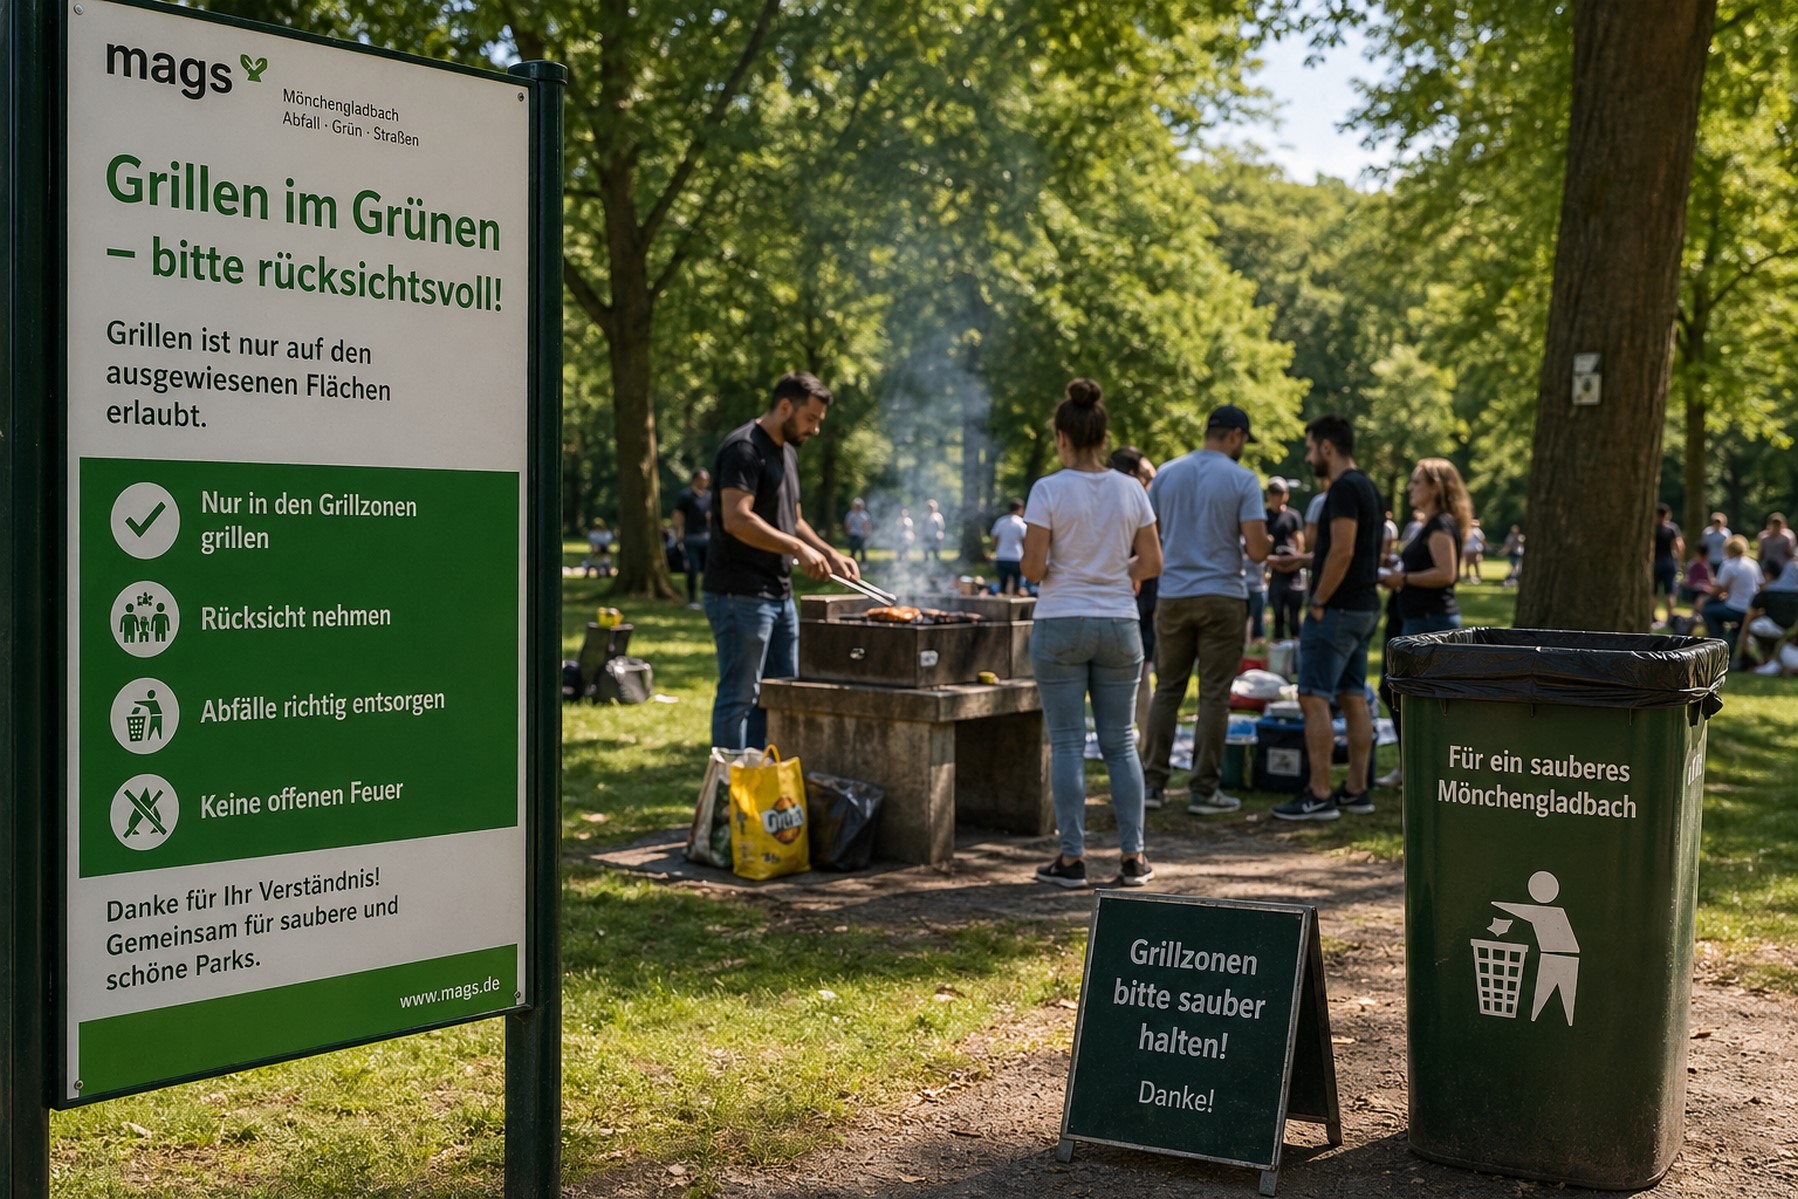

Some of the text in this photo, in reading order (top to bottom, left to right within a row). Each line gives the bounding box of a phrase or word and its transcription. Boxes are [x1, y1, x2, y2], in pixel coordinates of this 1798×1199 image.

[106, 44, 232, 99] mags
[282, 89, 398, 122] Mönchengladbach
[282, 111, 319, 129] Abfall
[331, 120, 362, 136] Grün
[373, 127, 418, 146] Straßen
[106, 155, 499, 251] Grillen im Grünen
[152, 236, 243, 284] bitte
[258, 252, 501, 311] rücksichtsvoll!
[106, 321, 370, 364] Grillen ist nur auf den
[106, 366, 390, 401] ausgewiesenen Flächen
[106, 400, 206, 427] erlaubt.
[202, 491, 416, 516] Nur in den Grillzonen
[201, 526, 268, 554] grillen
[201, 604, 390, 630] Rücksicht nehmen
[200, 693, 444, 723] Abfälle richtig entsorgen
[1449, 746, 1629, 781] Für ein sauberes
[201, 781, 403, 818] Keine offenen Feuer
[1438, 779, 1637, 818] Mönchengladbach
[107, 867, 380, 922] Danke für Ihr Verständnis!
[106, 895, 397, 956] Gemeinsam für saubere und
[106, 950, 260, 990] schöne Parks.
[1130, 939, 1257, 975] Grillzonen
[400, 976, 500, 1008] www.mags.de
[1113, 978, 1265, 1019] bitte sauber
[1138, 1023, 1228, 1059] halten!
[1138, 1081, 1214, 1112] Danke!
